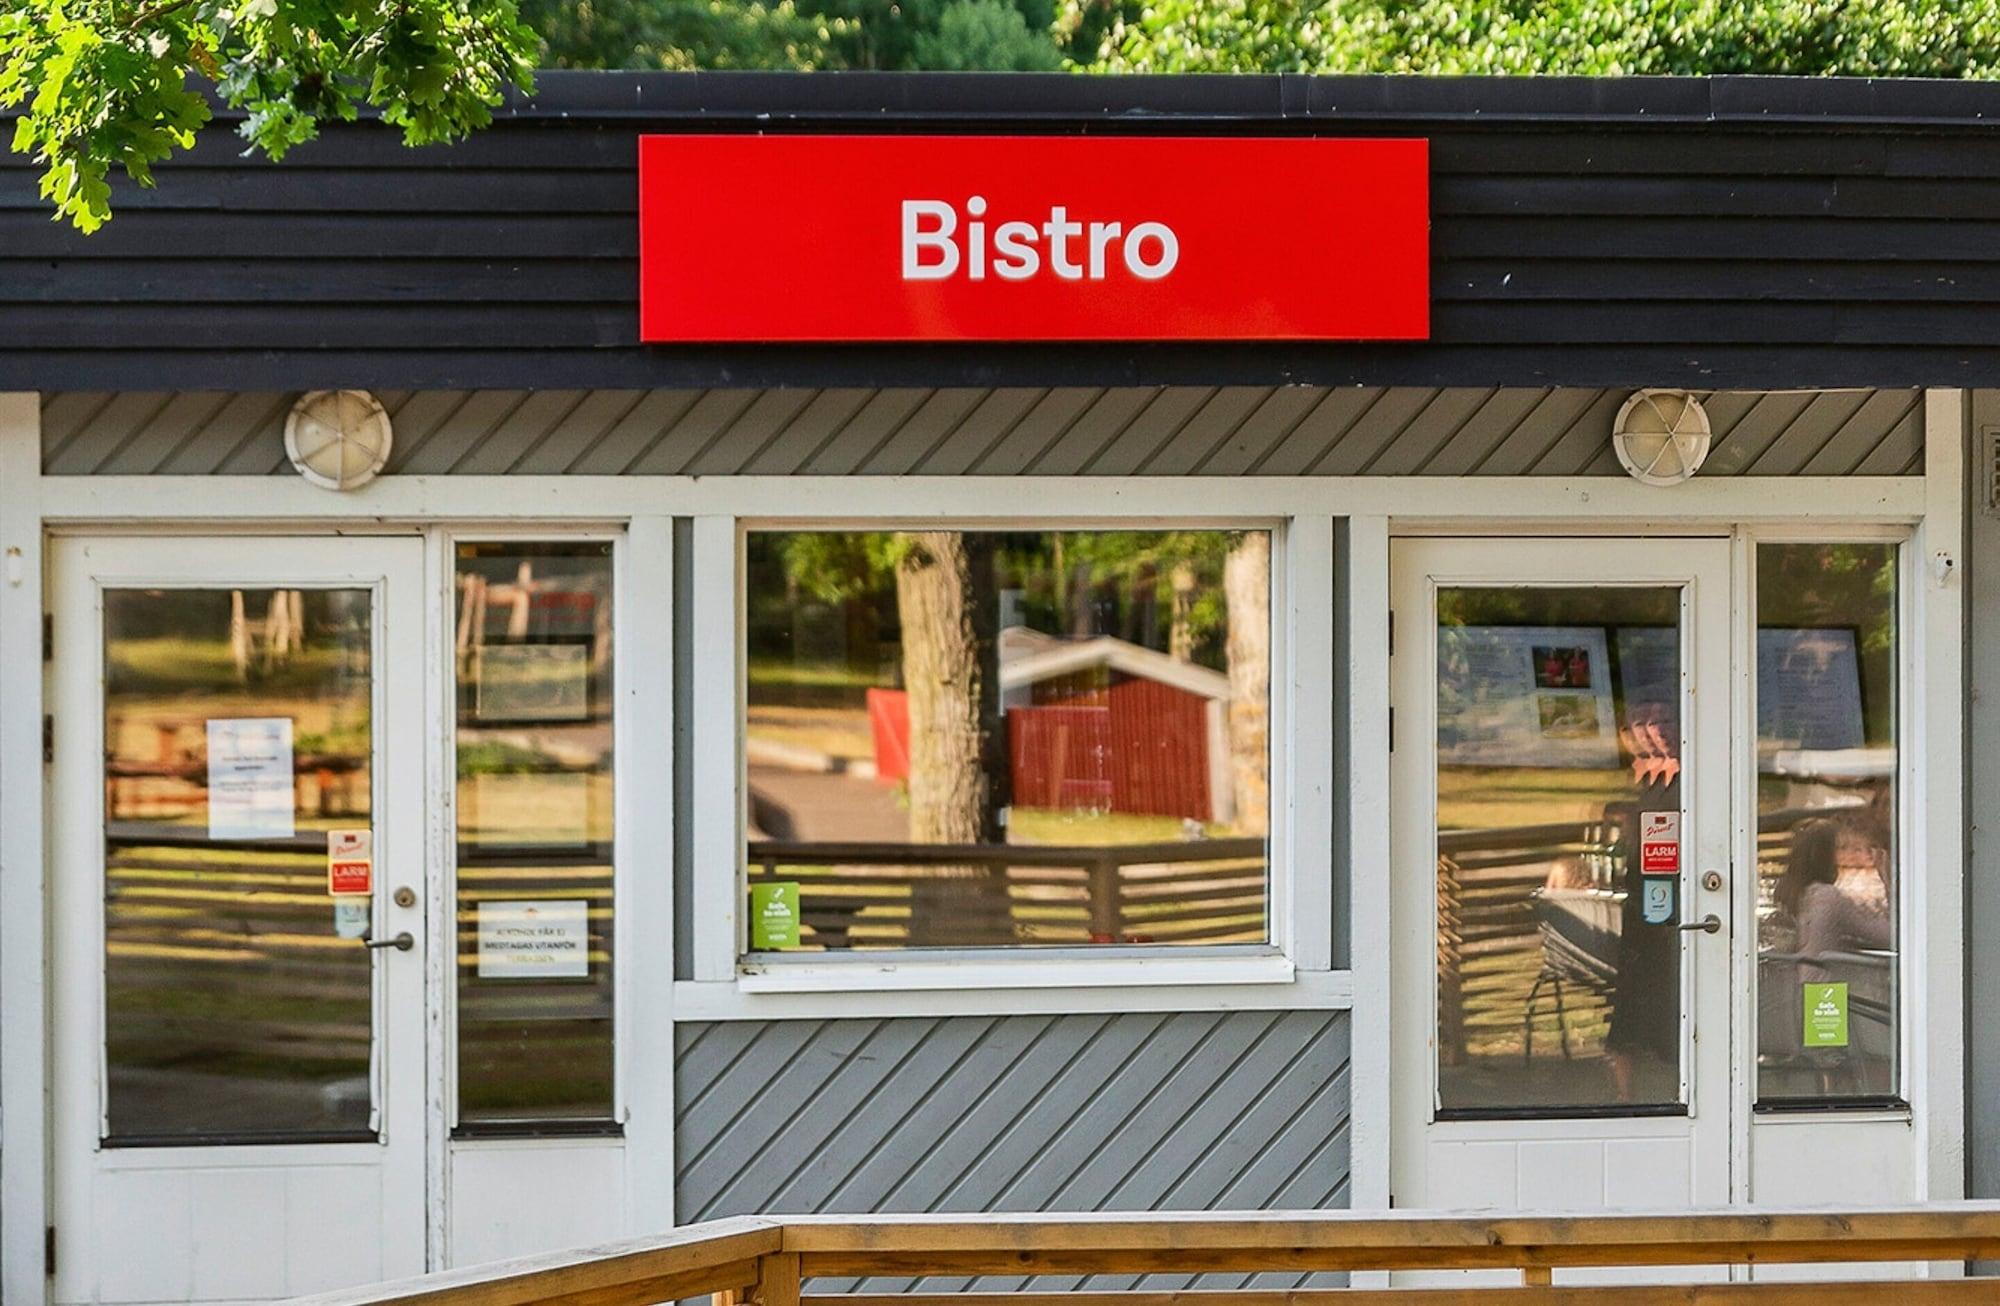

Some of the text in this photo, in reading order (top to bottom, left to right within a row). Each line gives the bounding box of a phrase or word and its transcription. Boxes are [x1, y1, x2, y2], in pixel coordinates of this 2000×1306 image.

[902, 195, 1180, 280] Bistro
[1645, 846, 1677, 857] LARM
[334, 864, 368, 877] LARM
